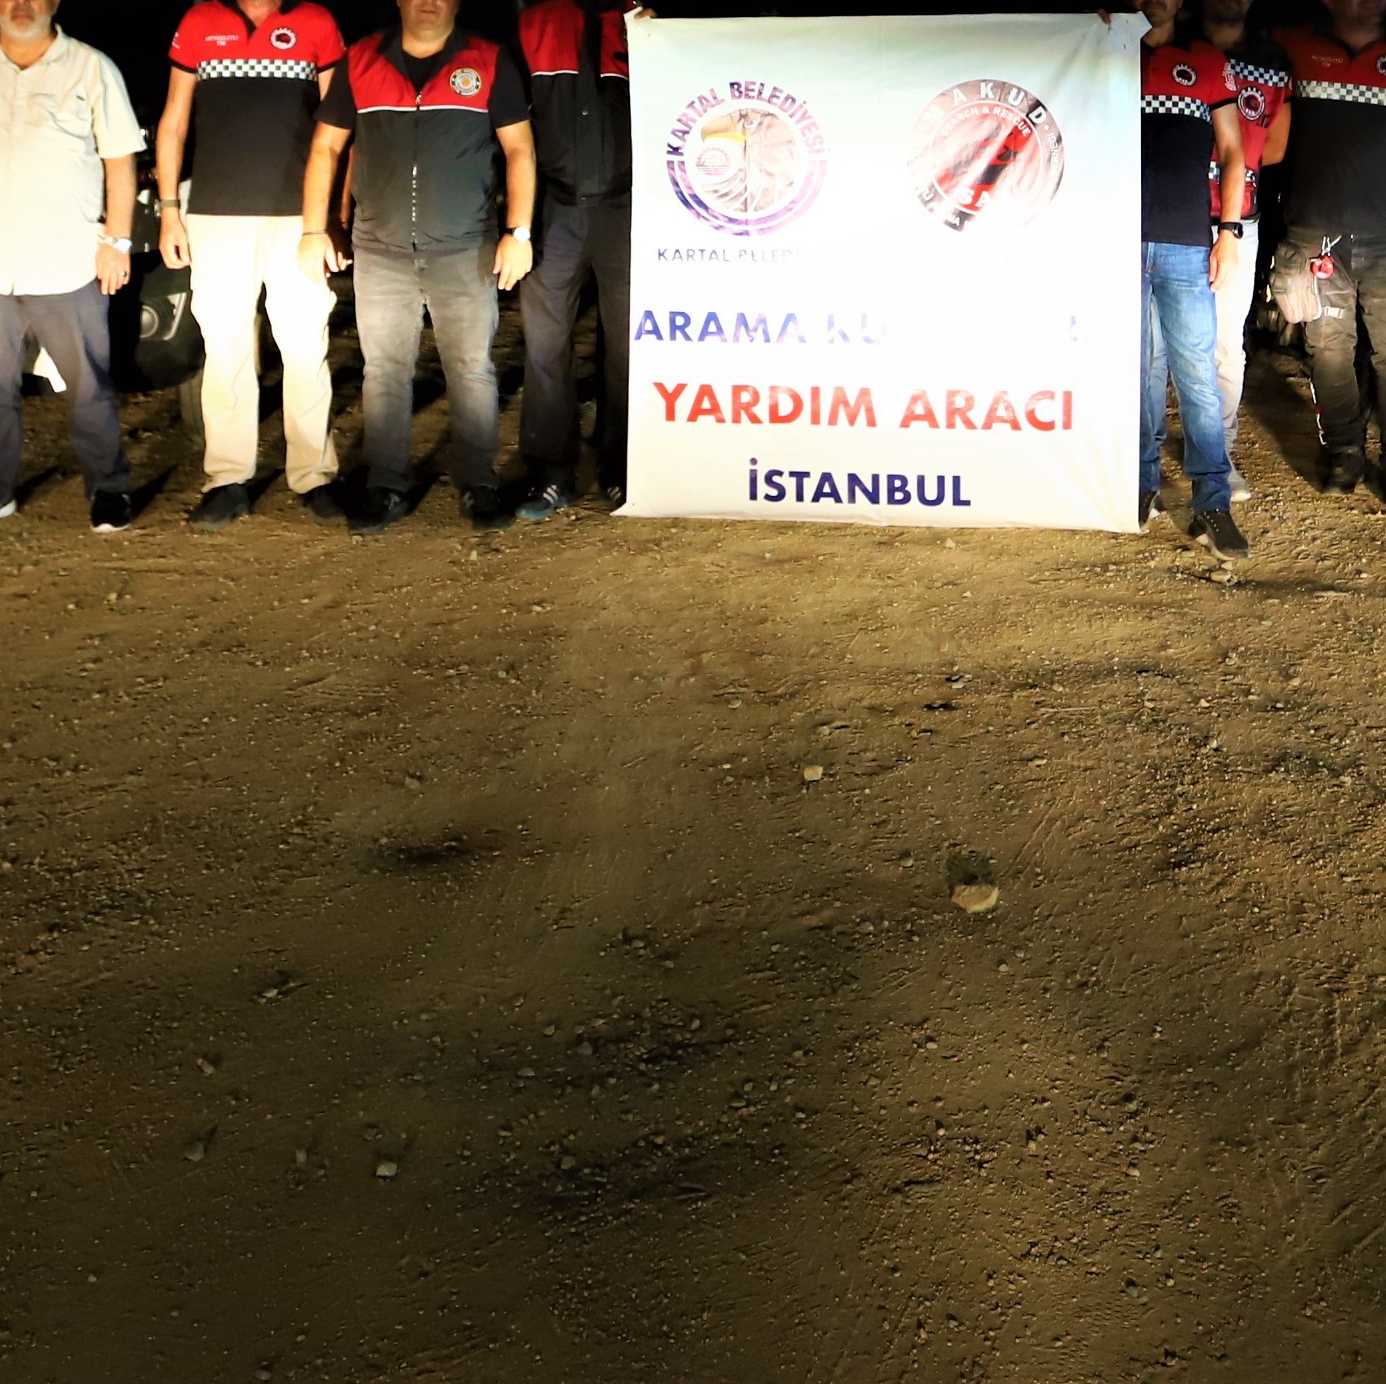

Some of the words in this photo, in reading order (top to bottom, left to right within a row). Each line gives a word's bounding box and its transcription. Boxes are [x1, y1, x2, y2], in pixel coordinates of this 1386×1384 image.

[666, 88, 726, 157] KARTAL
[657, 248, 730, 262] KARTAL
[633, 309, 807, 345] ARAMA
[652, 381, 878, 428] YARDIM
[899, 388, 1074, 432] ARACI
[748, 457, 971, 507] İSTANBUL
